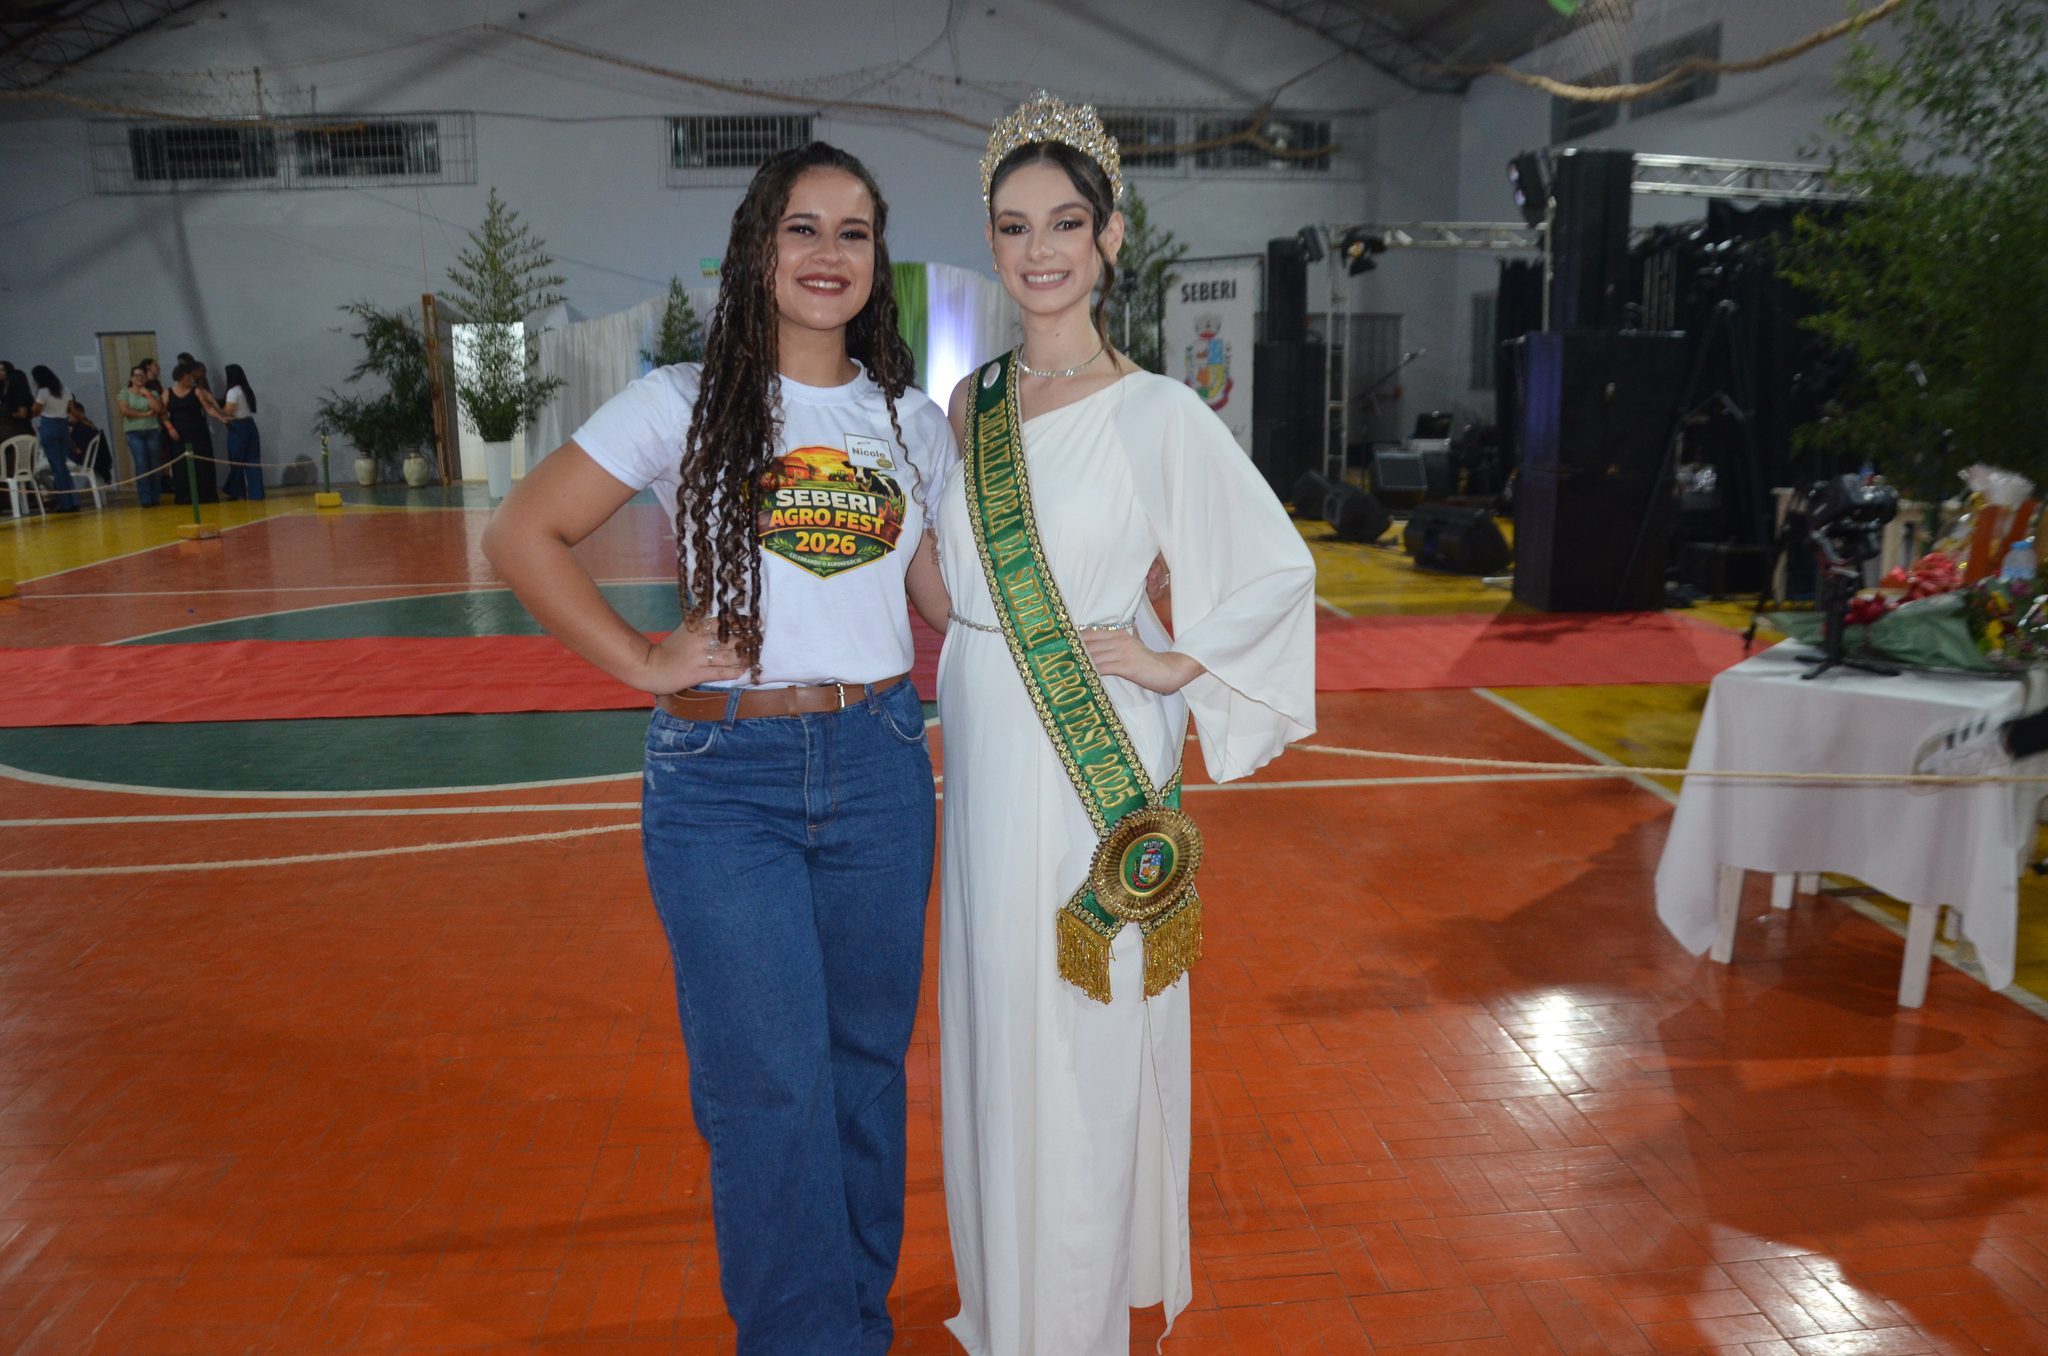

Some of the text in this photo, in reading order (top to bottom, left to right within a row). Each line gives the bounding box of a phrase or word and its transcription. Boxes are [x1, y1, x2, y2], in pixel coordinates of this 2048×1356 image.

[1181, 279, 1237, 303] SEBERI
[852, 447, 886, 459] Nicole
[775, 489, 877, 515] SEBERI
[769, 508, 885, 535] AGRO FEST
[795, 531, 857, 555] 2026
[789, 552, 821, 566] CELEBRANDO
[978, 398, 1138, 809] EMBAIXADORA DA SEBERI AGRO FEST 2025
